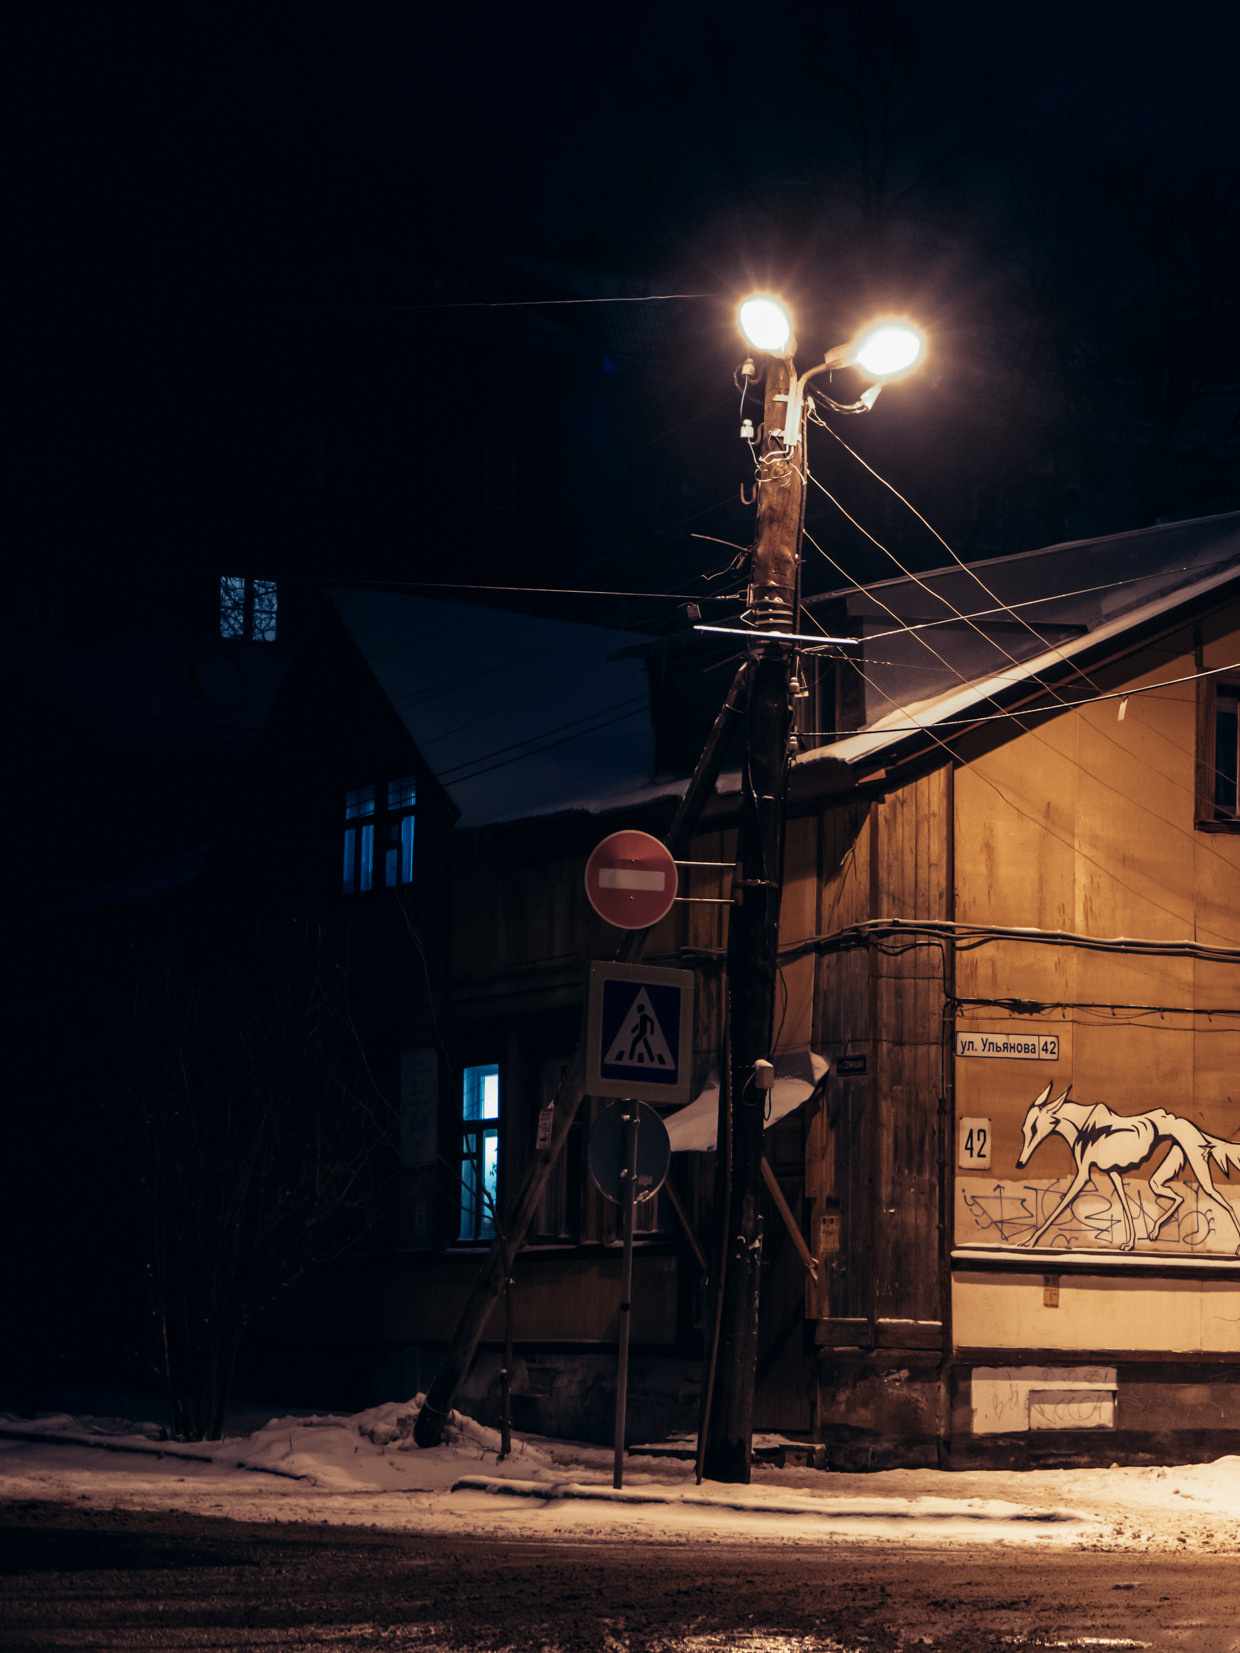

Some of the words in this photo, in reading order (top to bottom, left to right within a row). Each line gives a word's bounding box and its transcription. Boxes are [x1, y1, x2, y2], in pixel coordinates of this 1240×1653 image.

[960, 1040, 978, 1054] ул.
[981, 1038, 1037, 1054] Ульянова
[1041, 1041, 1057, 1054] 42
[964, 1128, 987, 1158] 42
